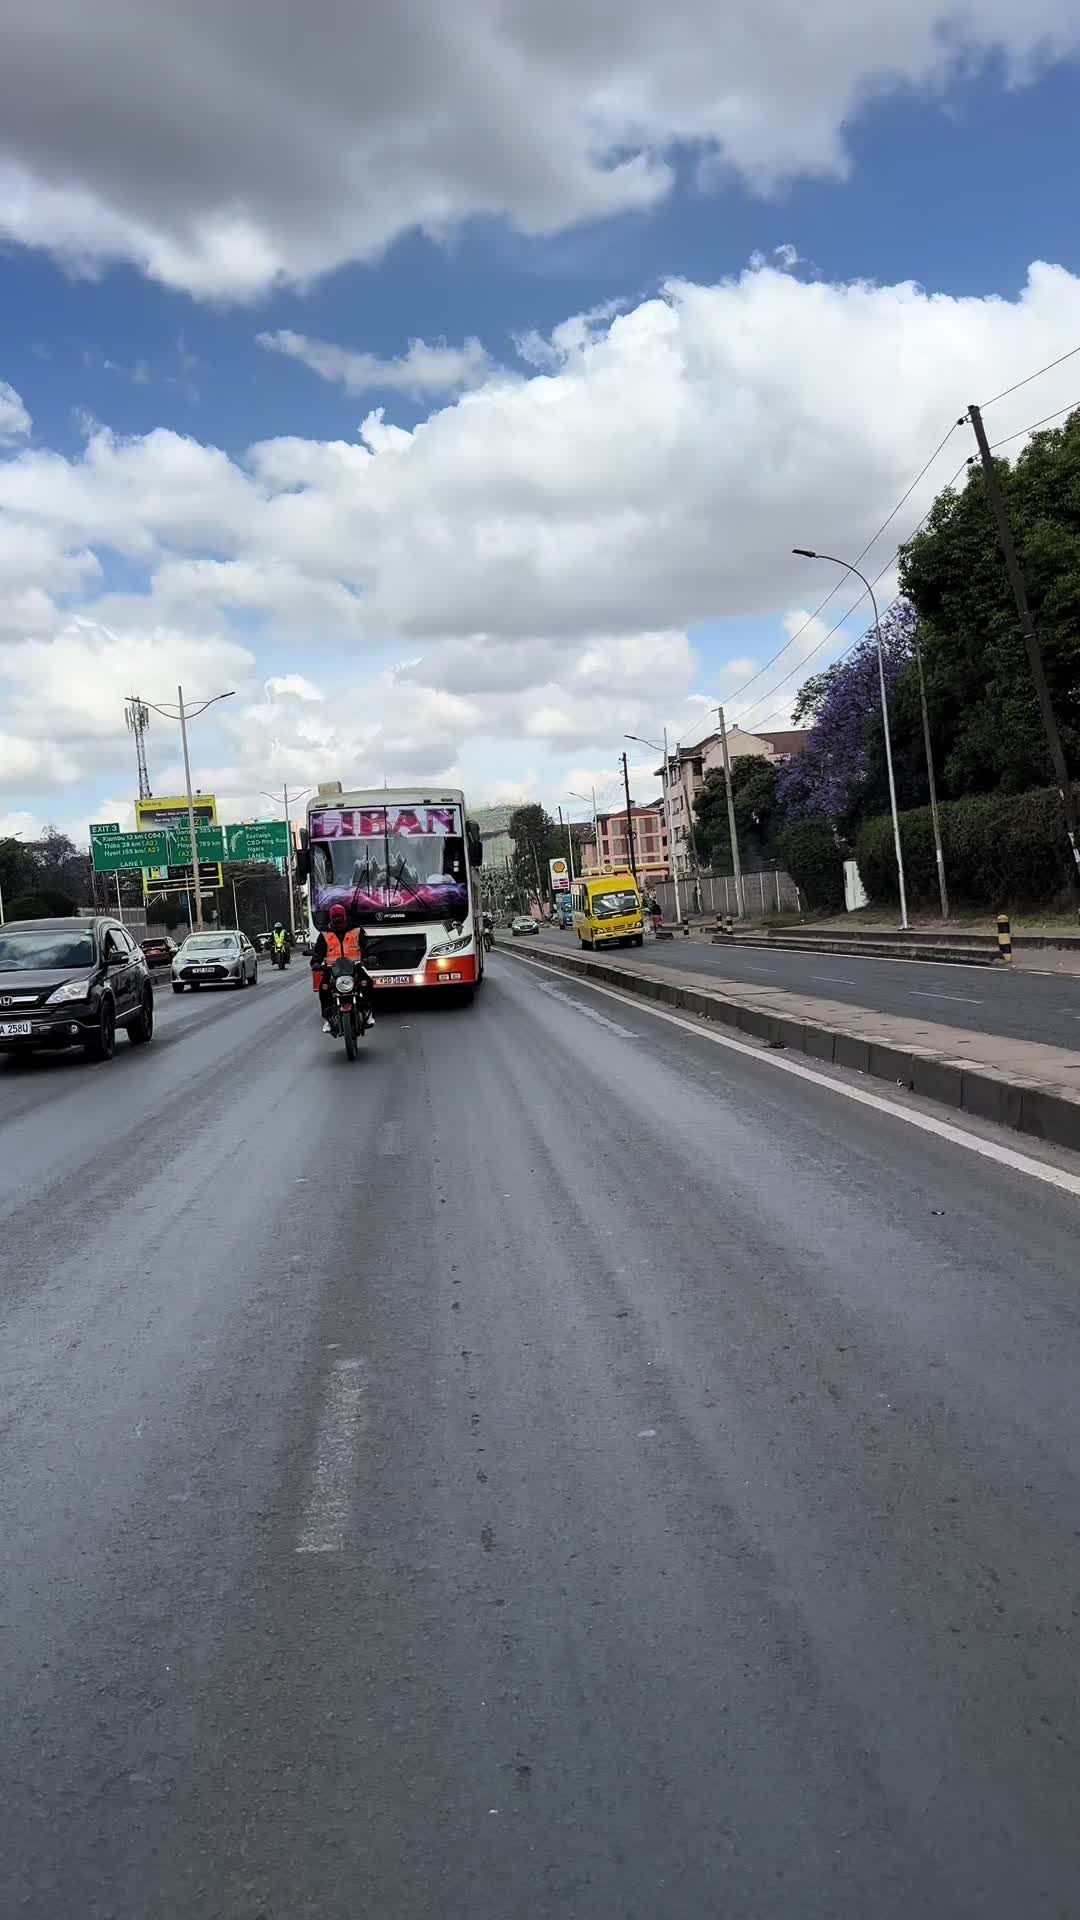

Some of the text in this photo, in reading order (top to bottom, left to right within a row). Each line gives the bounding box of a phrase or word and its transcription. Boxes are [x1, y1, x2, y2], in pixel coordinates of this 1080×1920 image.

[311, 807, 458, 839] LIBAN
[111, 824, 117, 832] 3
[120, 860, 139, 868] LANE
[8, 1023, 29, 1034] 258U
